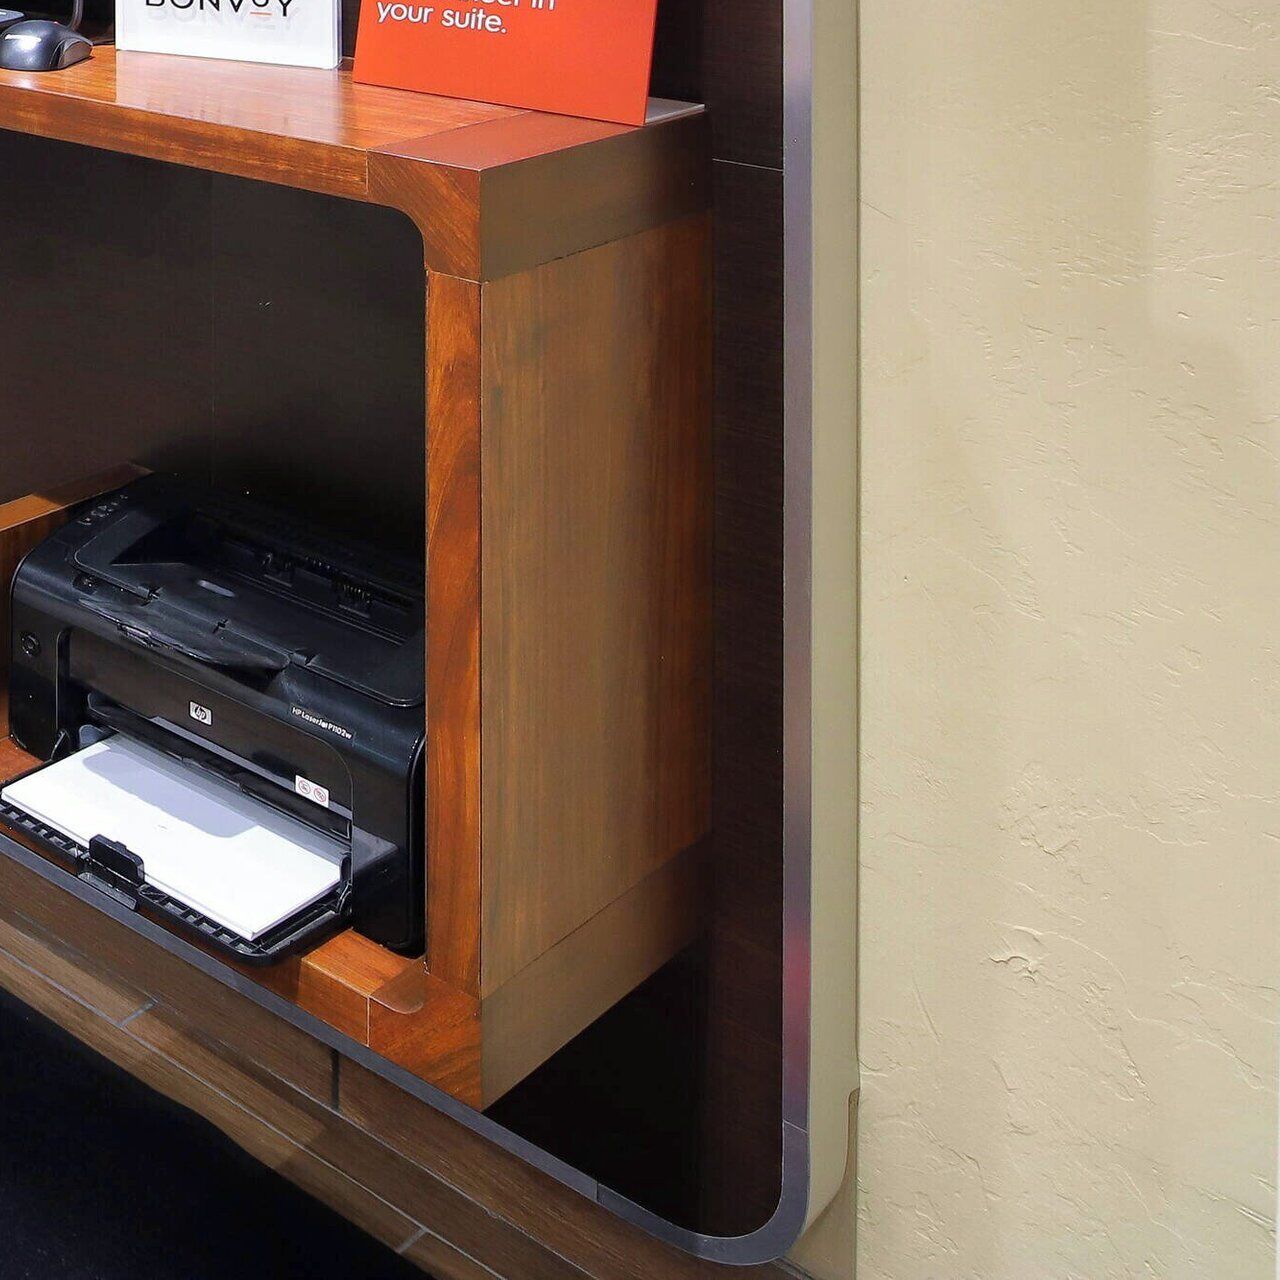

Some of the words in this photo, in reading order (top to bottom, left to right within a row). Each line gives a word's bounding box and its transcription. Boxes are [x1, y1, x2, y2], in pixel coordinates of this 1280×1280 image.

[377, 1, 434, 23] your
[441, 8, 507, 33] suite.
[291, 706, 302, 716] HP
